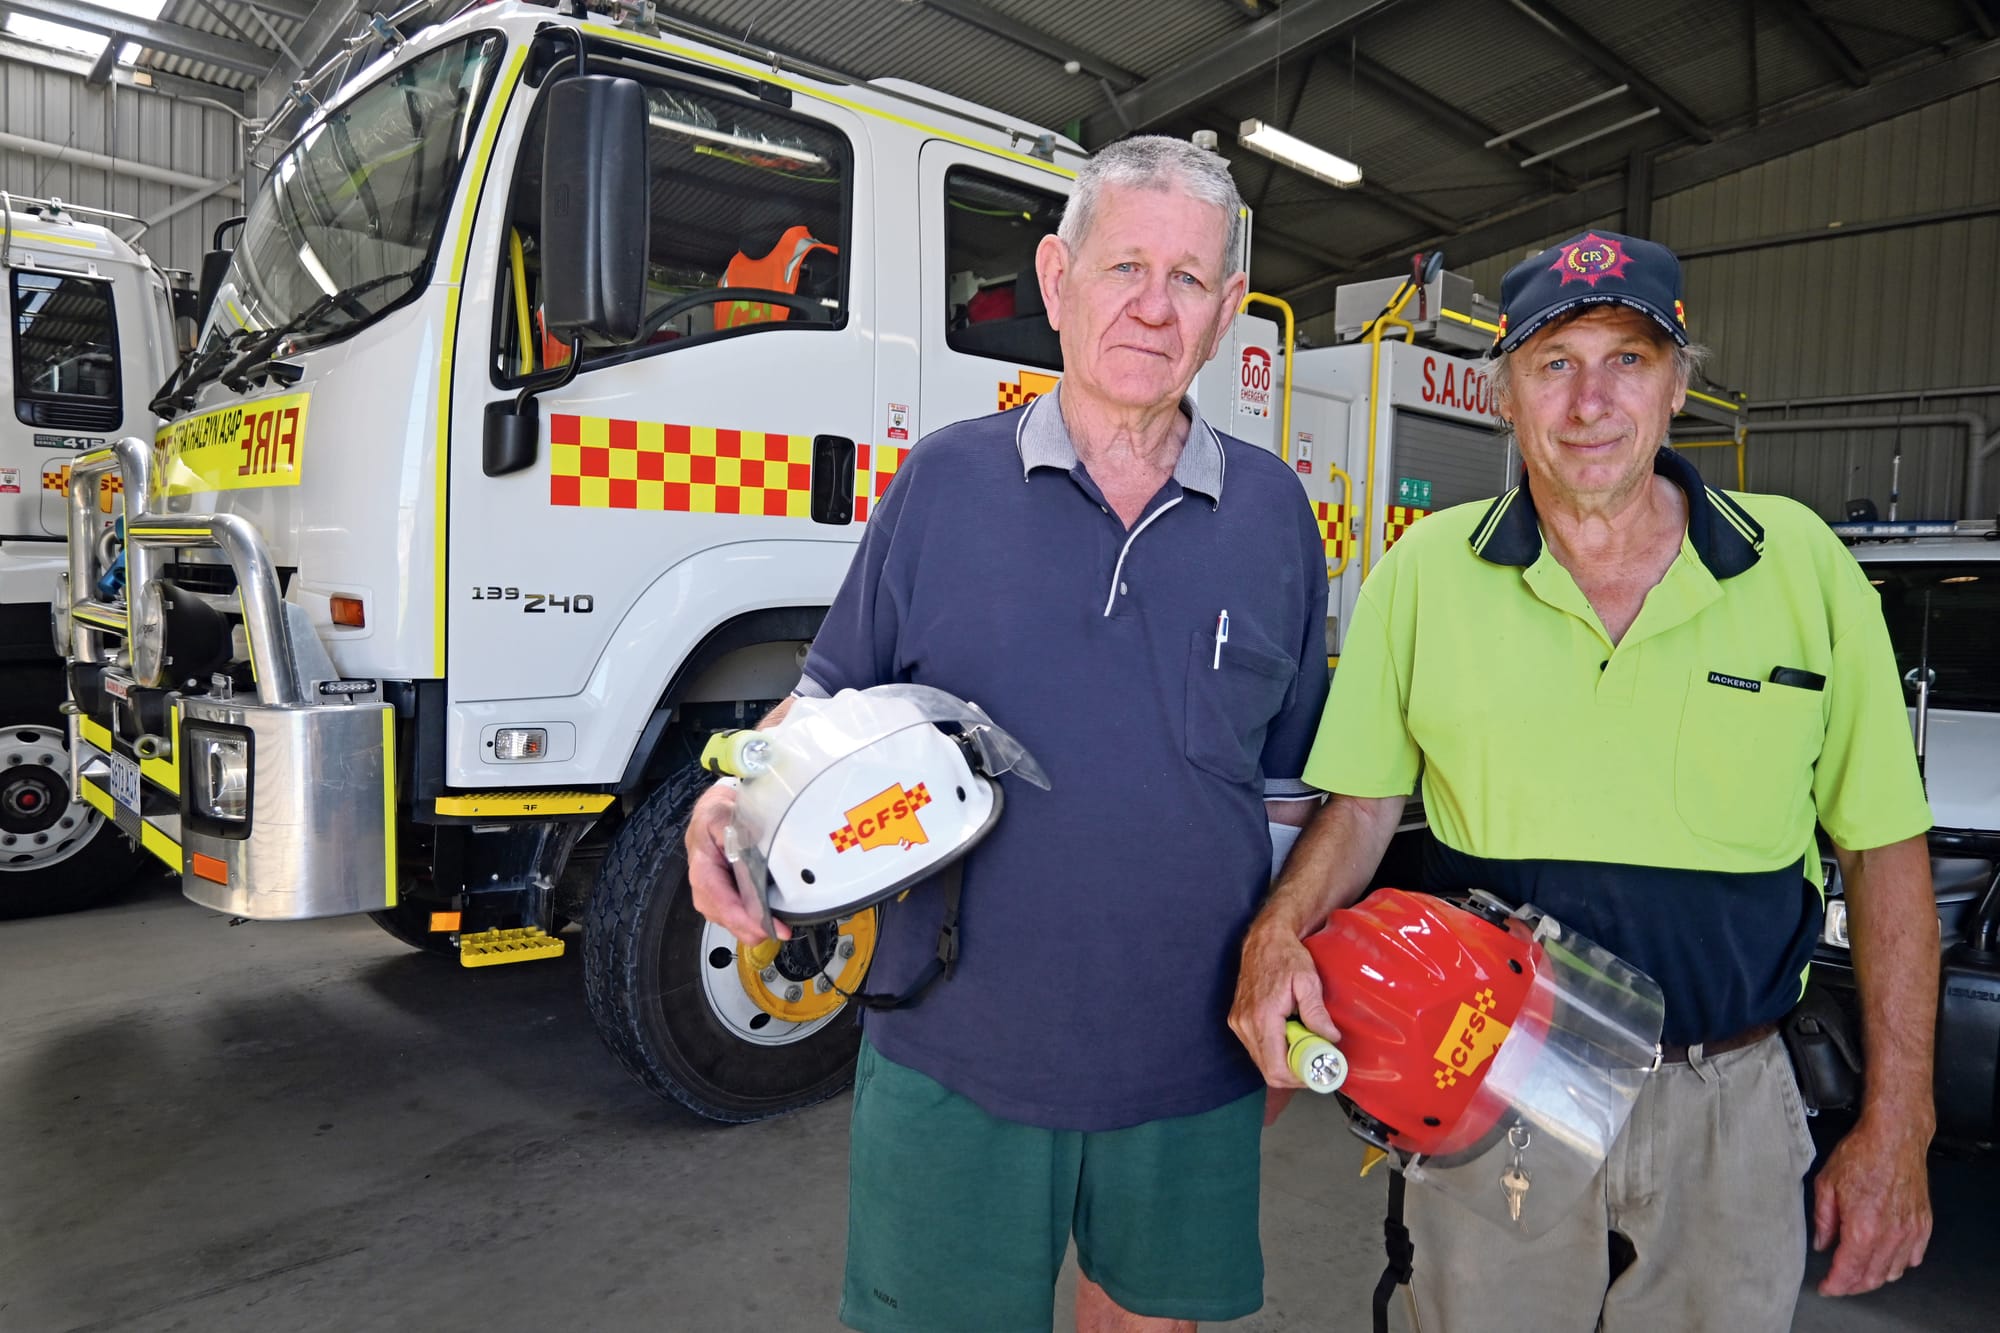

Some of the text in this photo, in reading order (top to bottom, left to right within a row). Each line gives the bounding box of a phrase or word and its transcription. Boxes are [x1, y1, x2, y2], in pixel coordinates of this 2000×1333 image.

[1581, 251, 1602, 263] CFS
[1242, 363, 1270, 391] 000
[1240, 389, 1270, 404] EMERGENCY
[173, 409, 243, 456] STRATHALBYN A34P
[472, 586, 519, 600] 139
[523, 593, 594, 613] 240
[857, 799, 909, 839] CFS
[1450, 1012, 1487, 1068] CFS
